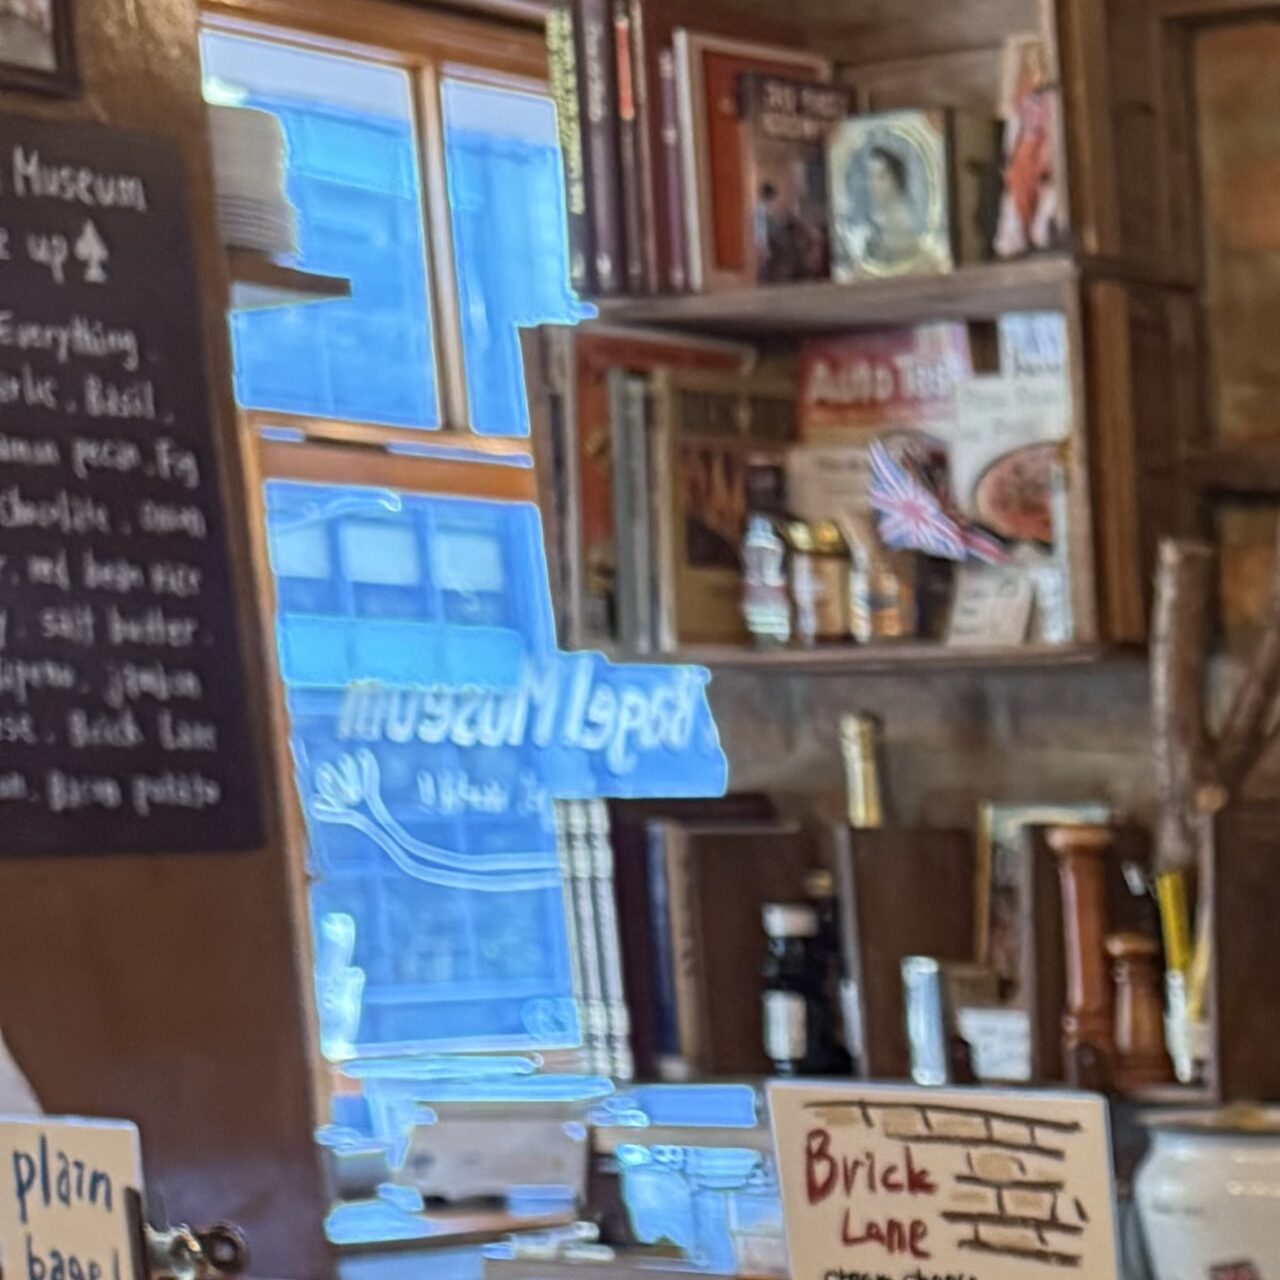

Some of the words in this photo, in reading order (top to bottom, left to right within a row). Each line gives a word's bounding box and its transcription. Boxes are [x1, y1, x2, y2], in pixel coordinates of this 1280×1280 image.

[13, 145, 148, 214] Museum
[13, 1132, 112, 1224] plain
[804, 1129, 939, 1207] Brick
[841, 1207, 932, 1259] Lane
